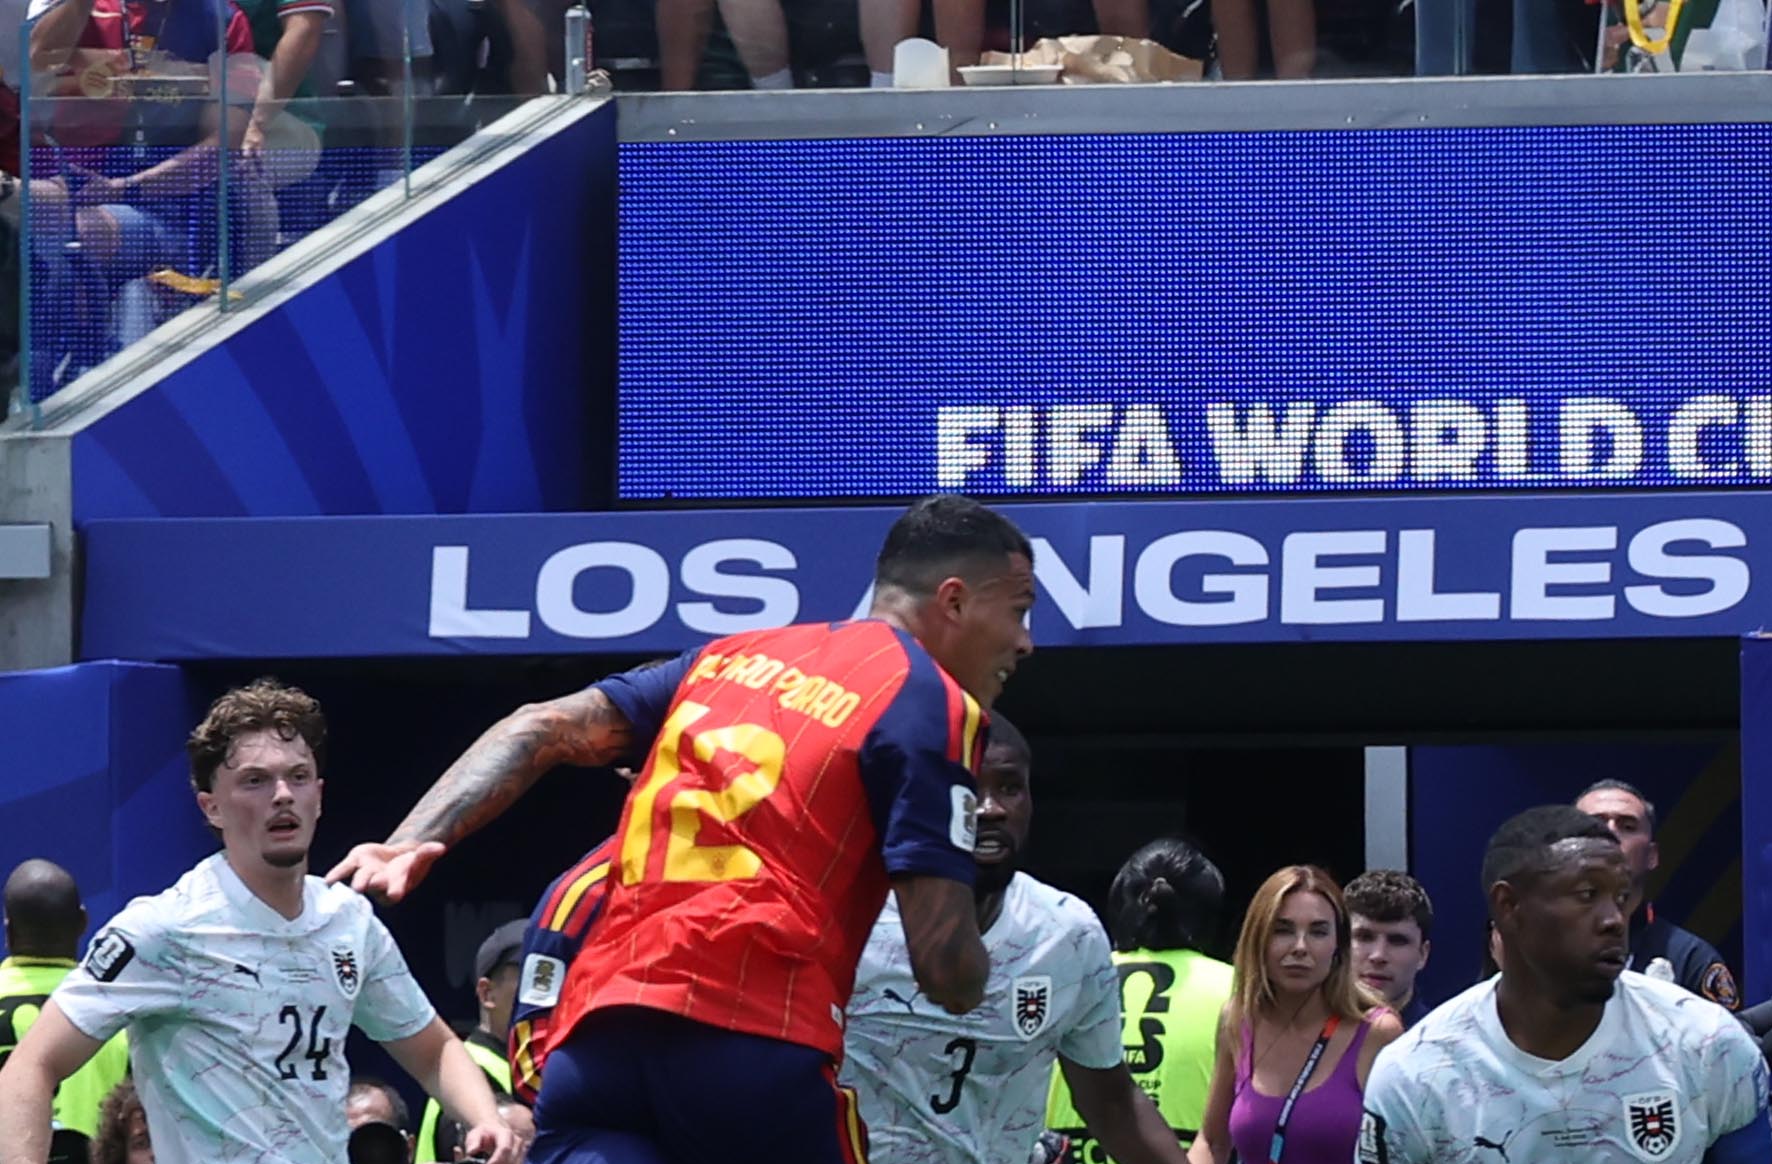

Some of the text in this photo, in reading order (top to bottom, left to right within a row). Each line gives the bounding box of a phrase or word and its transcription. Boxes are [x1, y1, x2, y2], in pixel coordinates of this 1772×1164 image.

[936, 404, 1182, 489] FIFA
[1206, 395, 1645, 487] WORLD
[428, 518, 1750, 640] LOS NGELES
[622, 700, 787, 885] 12
[274, 1004, 331, 1082] 24
[931, 1038, 977, 1115] 3
